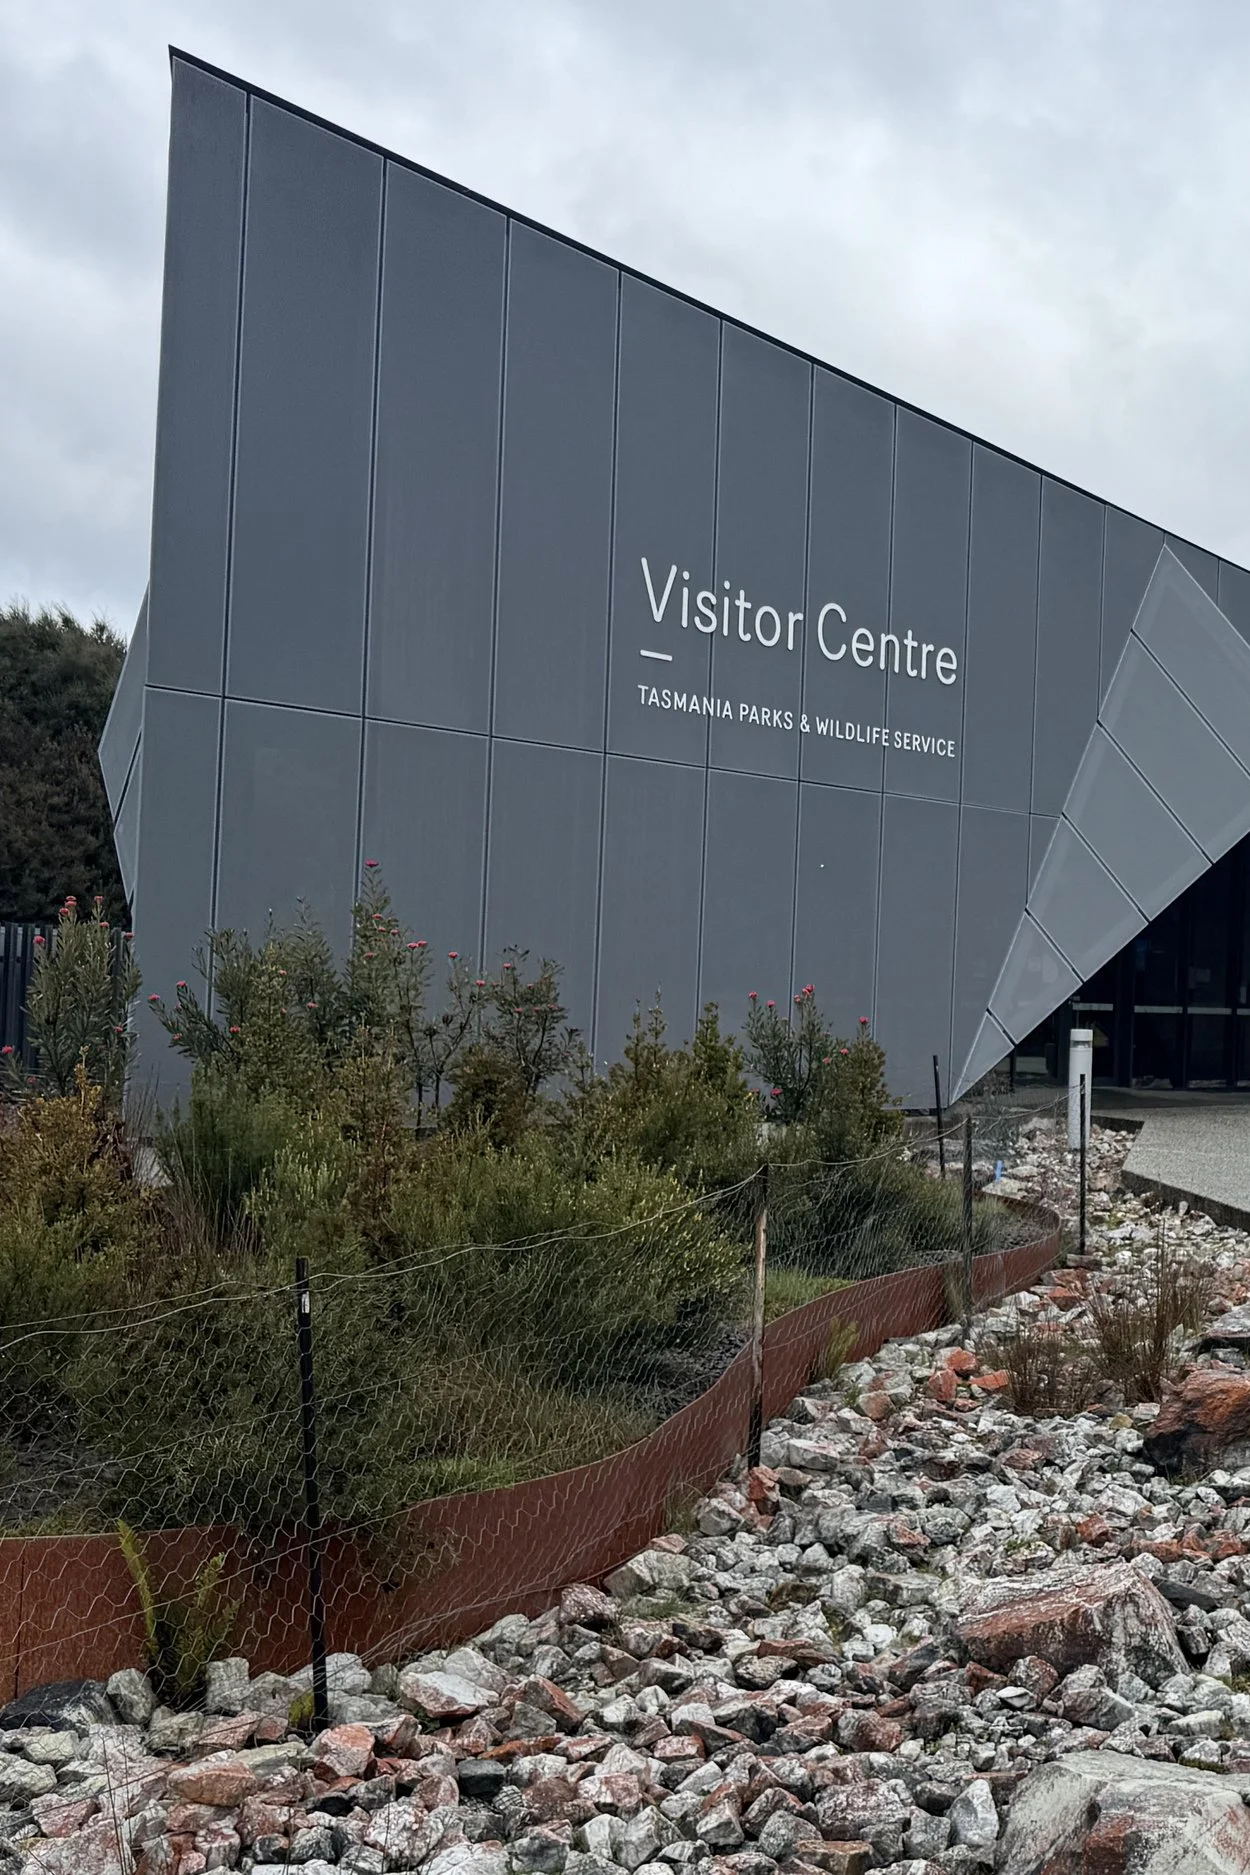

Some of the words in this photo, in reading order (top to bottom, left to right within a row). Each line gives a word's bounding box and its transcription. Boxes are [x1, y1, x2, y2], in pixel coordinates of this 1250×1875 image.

[641, 557, 804, 650] Visitor
[817, 602, 957, 685] Centre
[637, 684, 733, 720] TASMANIA
[739, 703, 793, 730] PARKS
[800, 713, 810, 733] &
[815, 716, 890, 747] WILDLIFE
[893, 730, 956, 758] SERVICE
